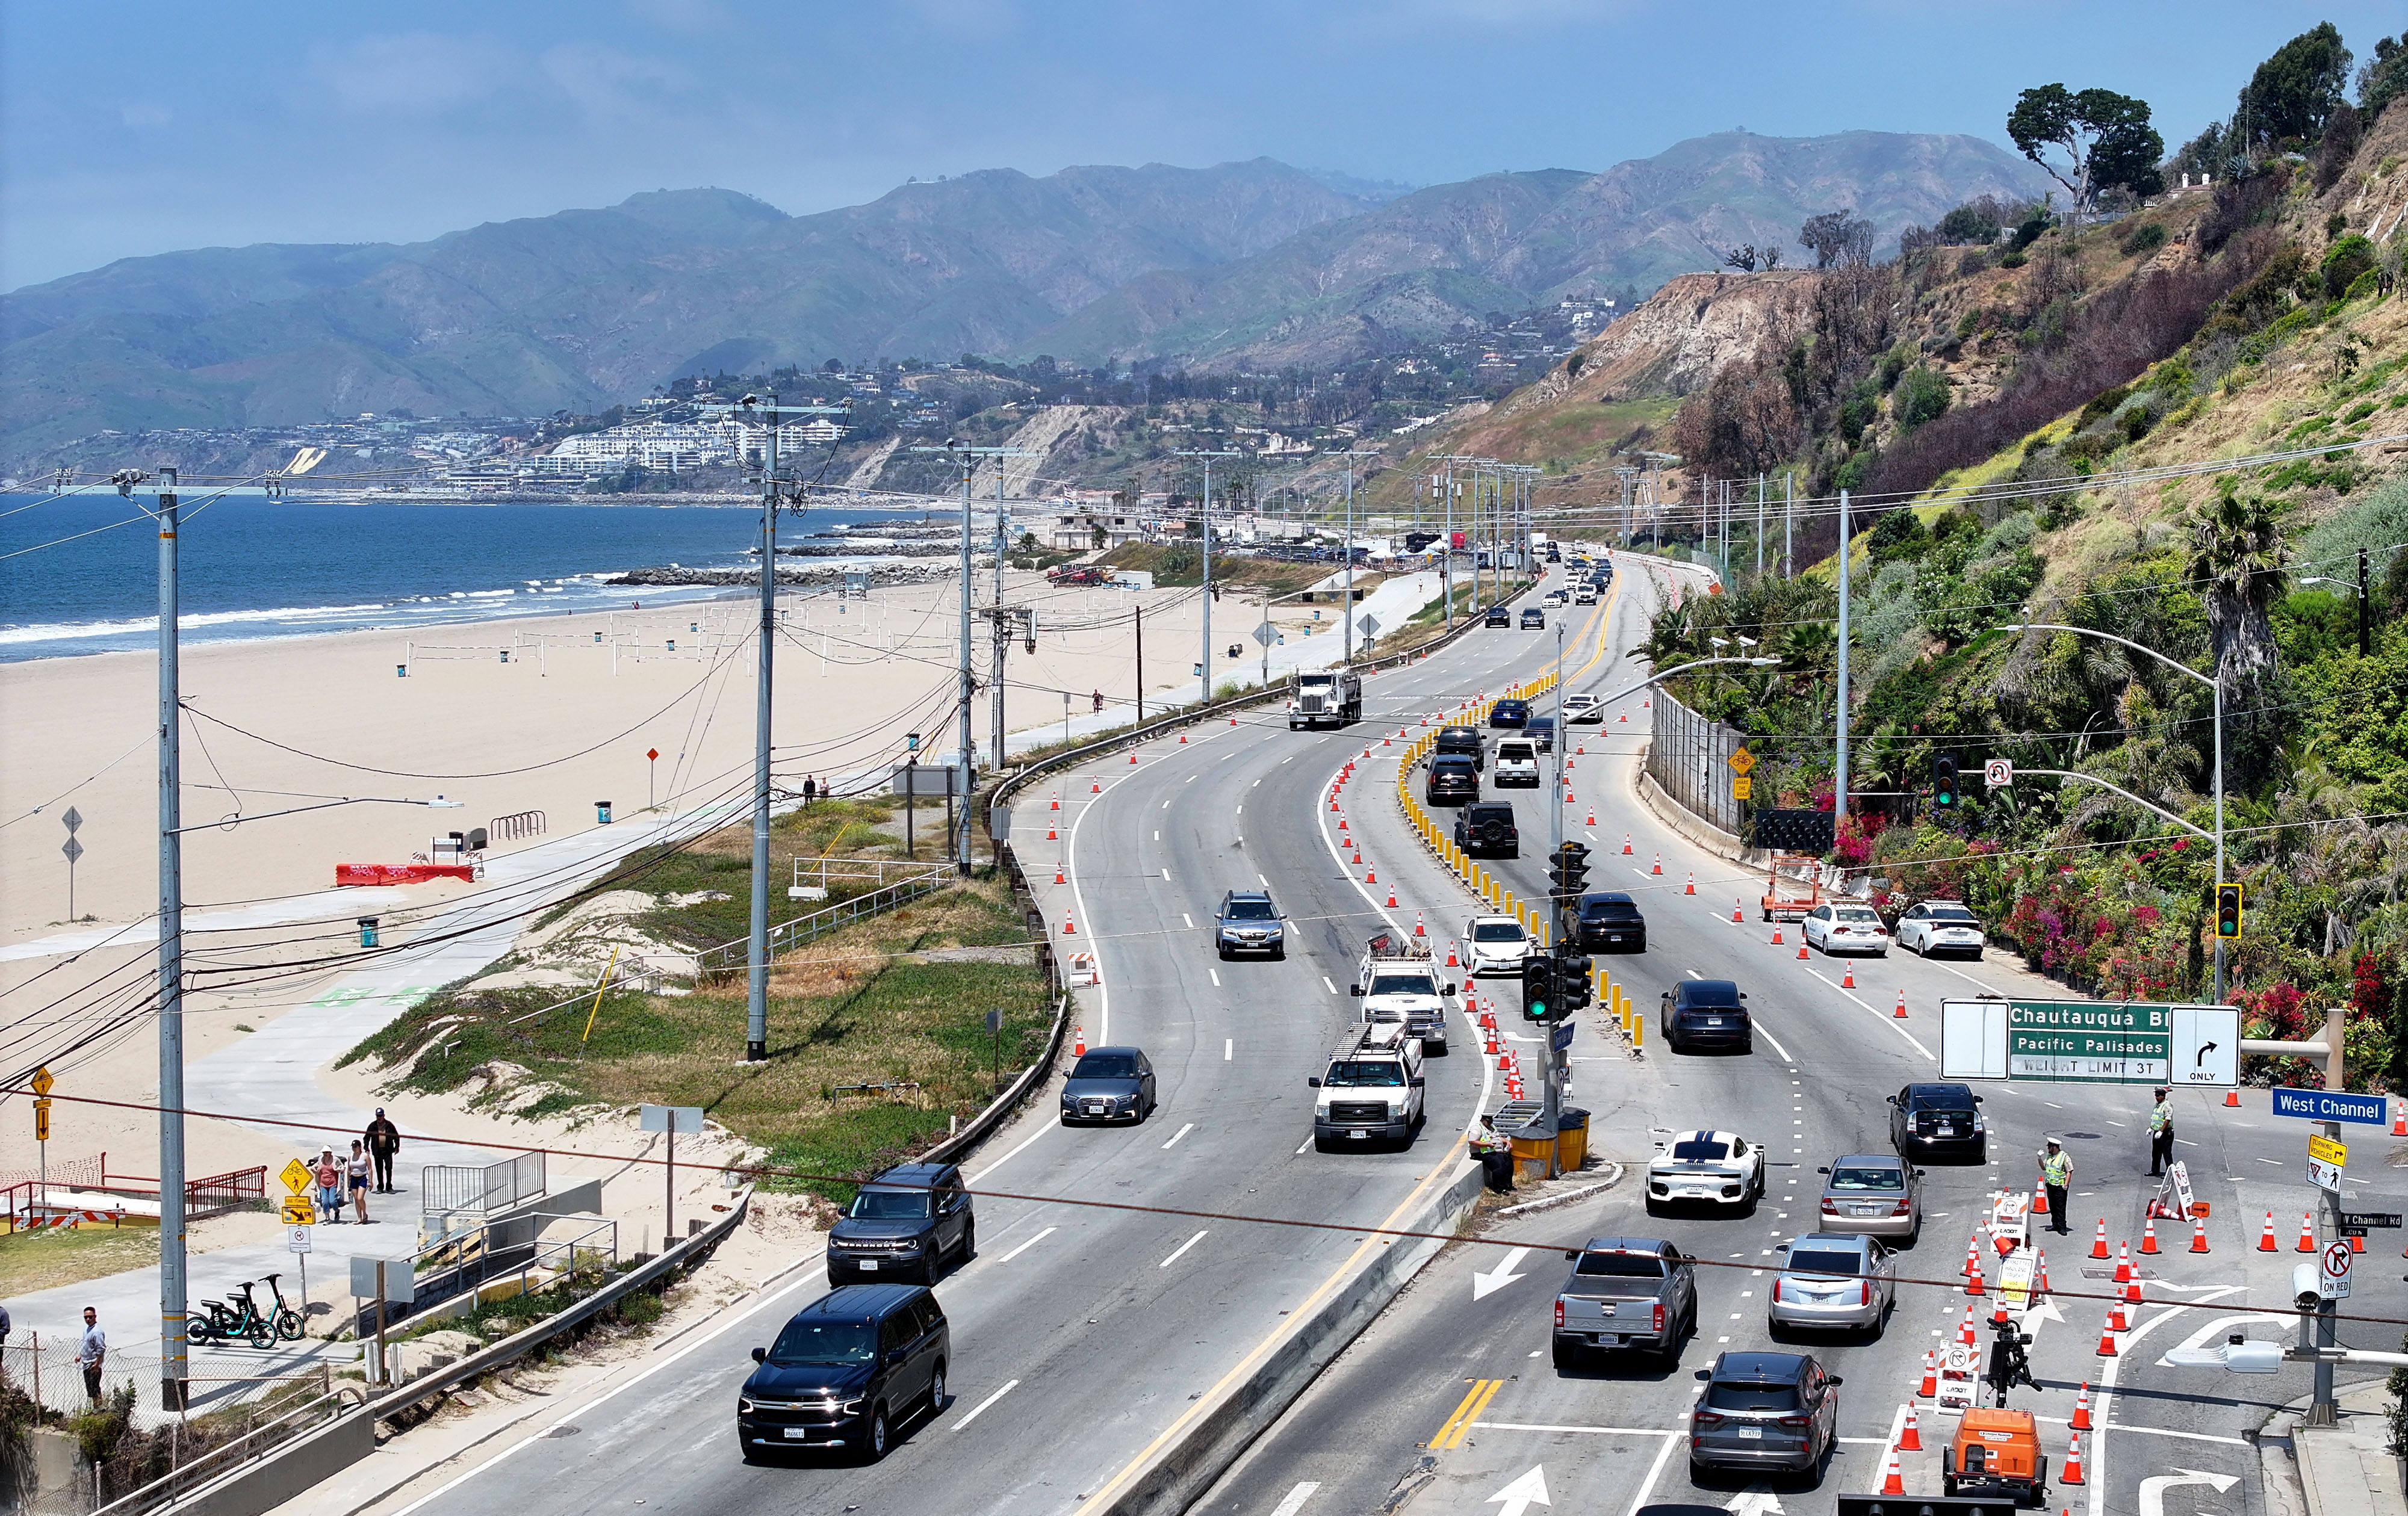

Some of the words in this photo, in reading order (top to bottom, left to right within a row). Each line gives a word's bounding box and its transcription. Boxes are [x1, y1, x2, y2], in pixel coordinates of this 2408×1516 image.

[2011, 1007, 2133, 1028] Chautauqua
[2018, 1038, 2074, 1050] Pacific
[2086, 1039, 2162, 1053] Palisades
[2025, 1059, 2078, 1072] WEIGHT
[2088, 1062, 2126, 1073] LIMIT
[2137, 1063, 2153, 1074] 3T
[2189, 1072, 2216, 1081] ONLY
[2280, 1095, 2315, 1113] West
[2321, 1099, 2379, 1118] Channel
[2312, 1139, 2333, 1151] TURNING
[2310, 1147, 2332, 1160] VEHICLES
[2353, 1215, 2386, 1225] Channel
[2390, 1216, 2401, 1225] Rd
[2324, 1282, 2334, 1292] ON
[2336, 1281, 2348, 1291] RED
[1566, 1320, 1651, 1329] RANGER
